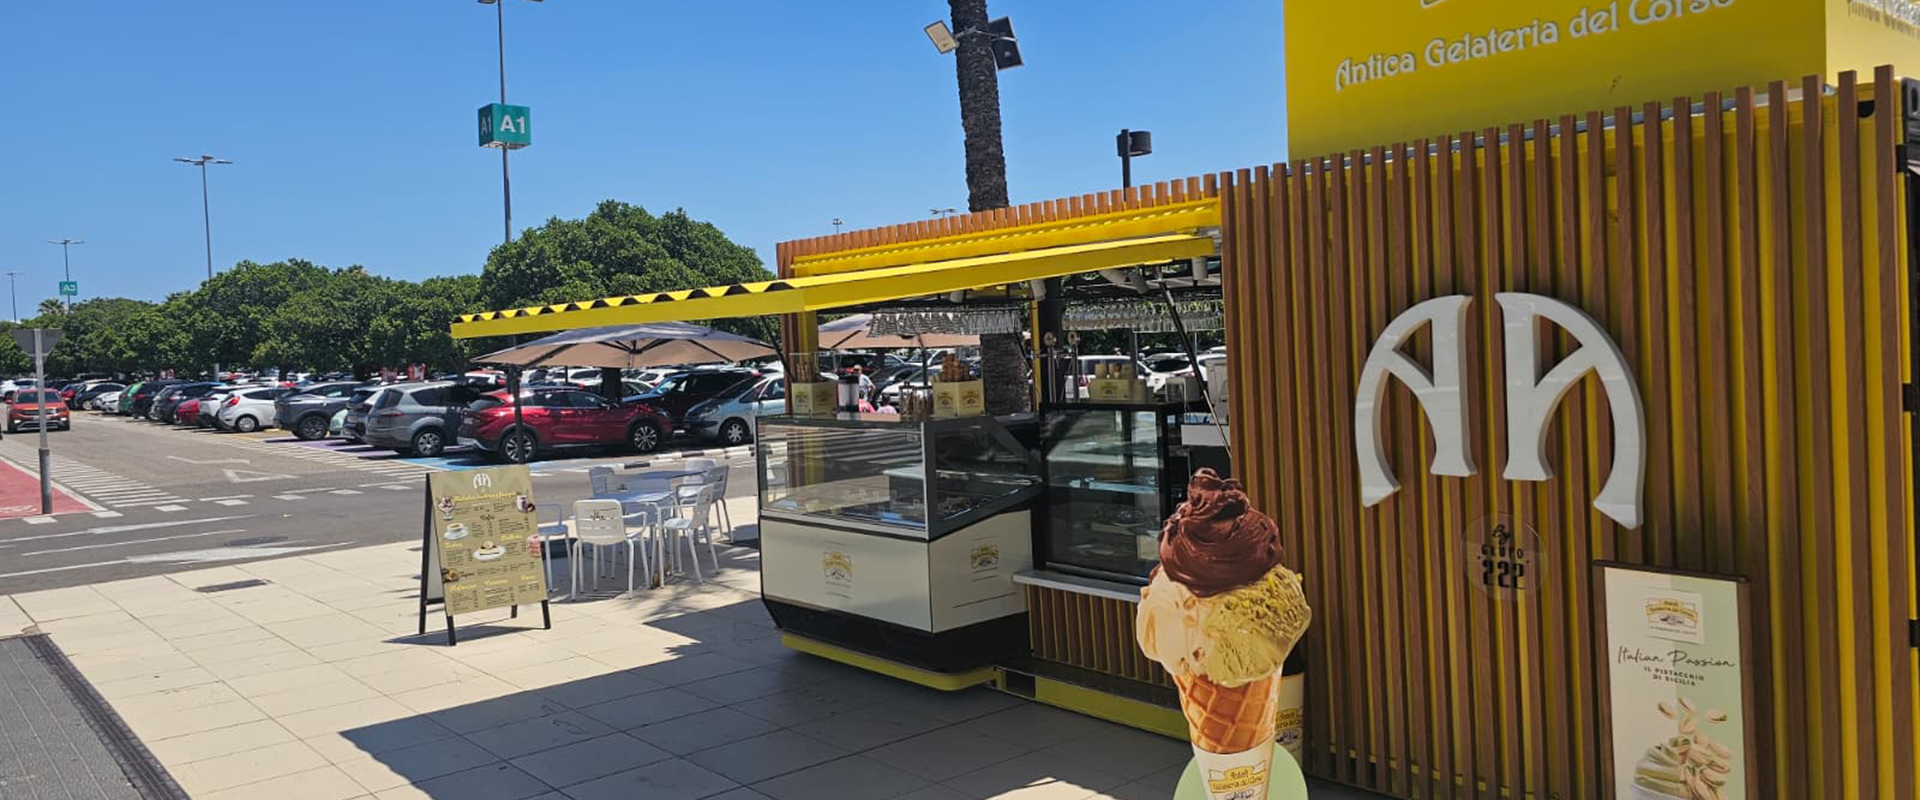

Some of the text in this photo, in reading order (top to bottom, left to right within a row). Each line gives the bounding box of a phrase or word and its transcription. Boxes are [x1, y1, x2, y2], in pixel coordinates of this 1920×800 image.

[1335, 57, 1416, 93] Antica
[1424, 18, 1559, 68] Gelateria
[1569, 1, 1619, 39] del
[480, 116, 492, 136] A1
[499, 114, 526, 134] A1
[1483, 559, 1527, 590] 222
[1617, 645, 1736, 668] Italian Passion
